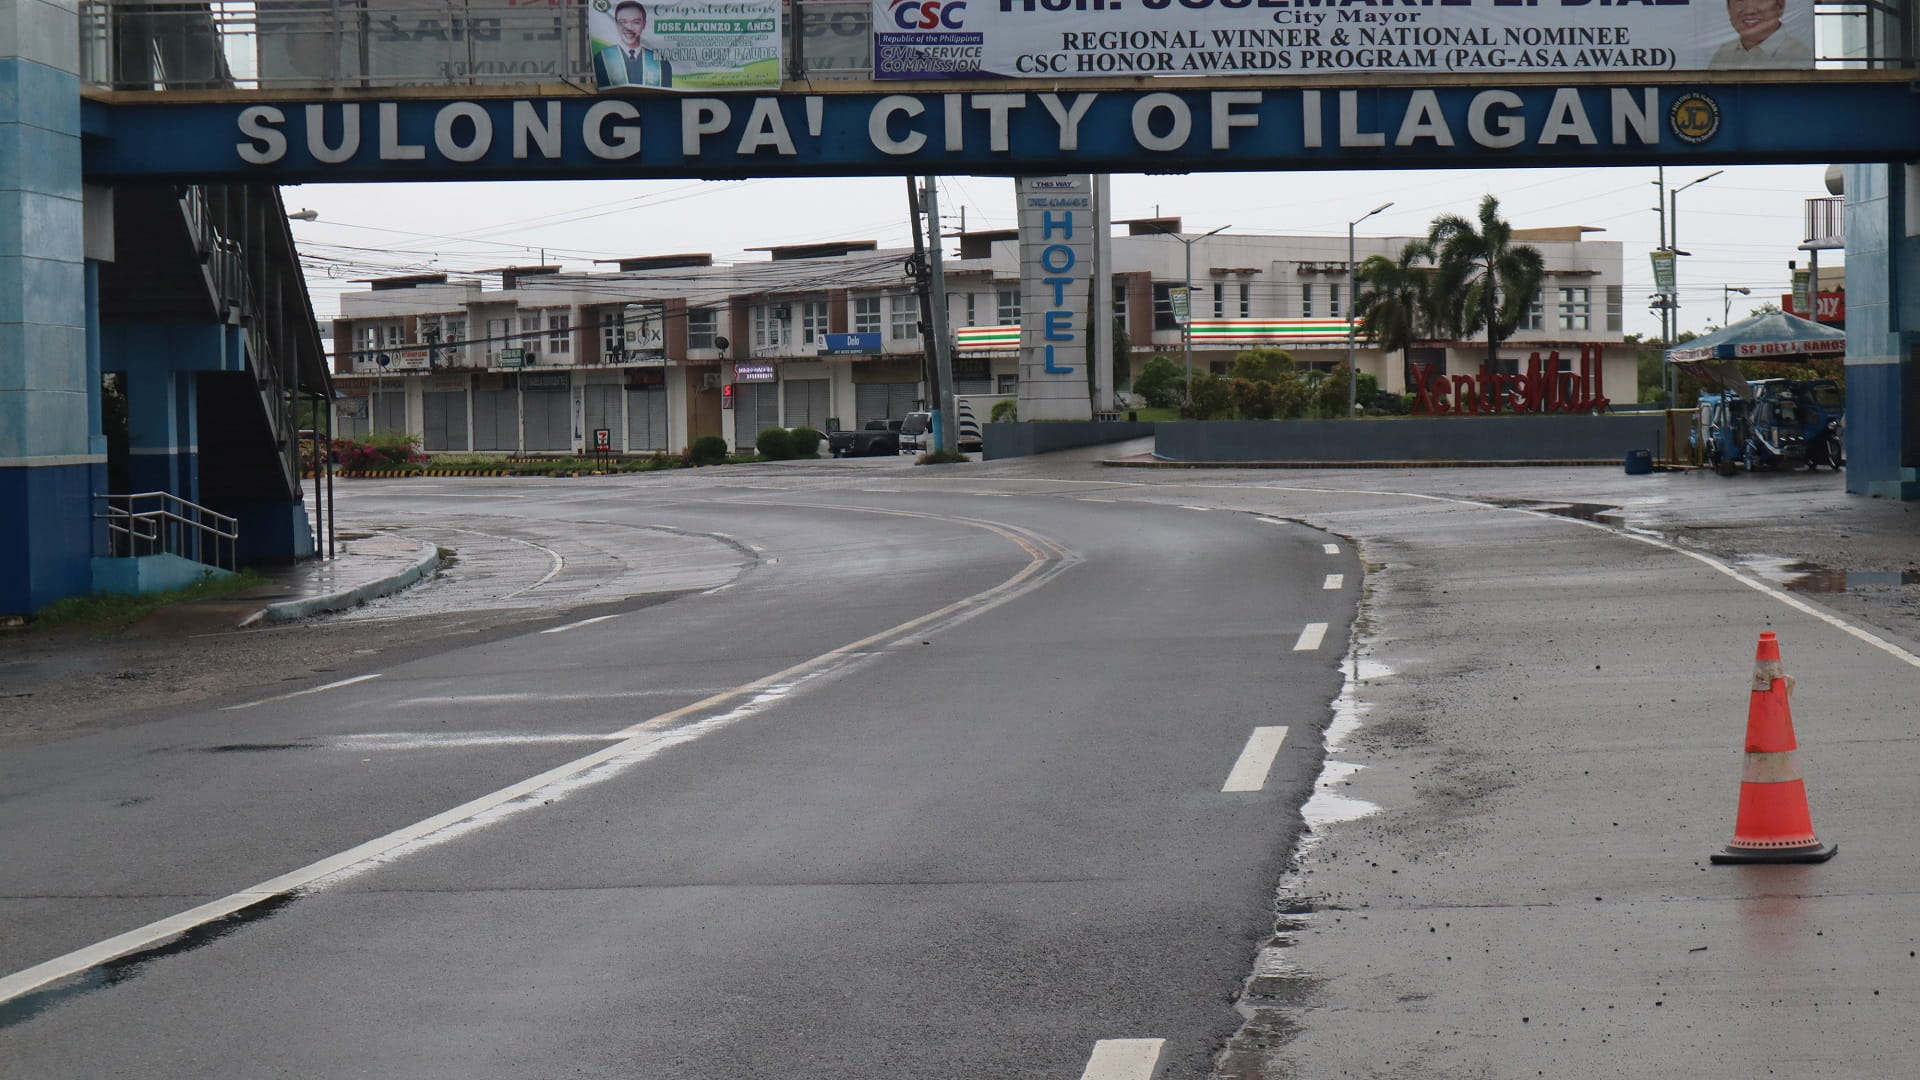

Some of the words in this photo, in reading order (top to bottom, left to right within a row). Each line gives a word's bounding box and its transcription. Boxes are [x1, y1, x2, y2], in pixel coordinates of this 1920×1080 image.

[894, 1, 967, 29] CSC
[1273, 10, 1327, 26] City
[1336, 9, 1421, 26] Mayor
[657, 22, 681, 32] JOSE
[883, 34, 914, 43] Republic
[916, 34, 924, 44] of
[925, 34, 937, 43] the
[940, 34, 980, 43] Philippines
[1062, 30, 1205, 50] REGIONAL
[1212, 28, 1322, 48] WINNER
[1330, 28, 1350, 46] &
[1359, 27, 1497, 46] NATIONAL
[1504, 27, 1630, 45] NOMINEE
[882, 46, 918, 59] CIVIL
[924, 46, 982, 59] SERVICE
[1016, 54, 1068, 73] CSC
[1076, 53, 1175, 71] HONOR
[1182, 51, 1292, 69] AWARDS
[1301, 50, 1437, 68] PROGRAM
[1445, 49, 1568, 70] (PAG-ASA
[1575, 48, 1676, 69] AWARD)
[882, 59, 981, 72] COMMISSION
[235, 101, 643, 164] SULONG
[681, 97, 825, 156] PA!
[868, 93, 1097, 155] CITY
[1132, 91, 1262, 151] OF
[1303, 88, 1659, 149] ILAGAN
[1042, 210, 1075, 374] HOTEL
[1761, 344, 1787, 353] JOEY
[1804, 340, 1845, 351] RAMOS
